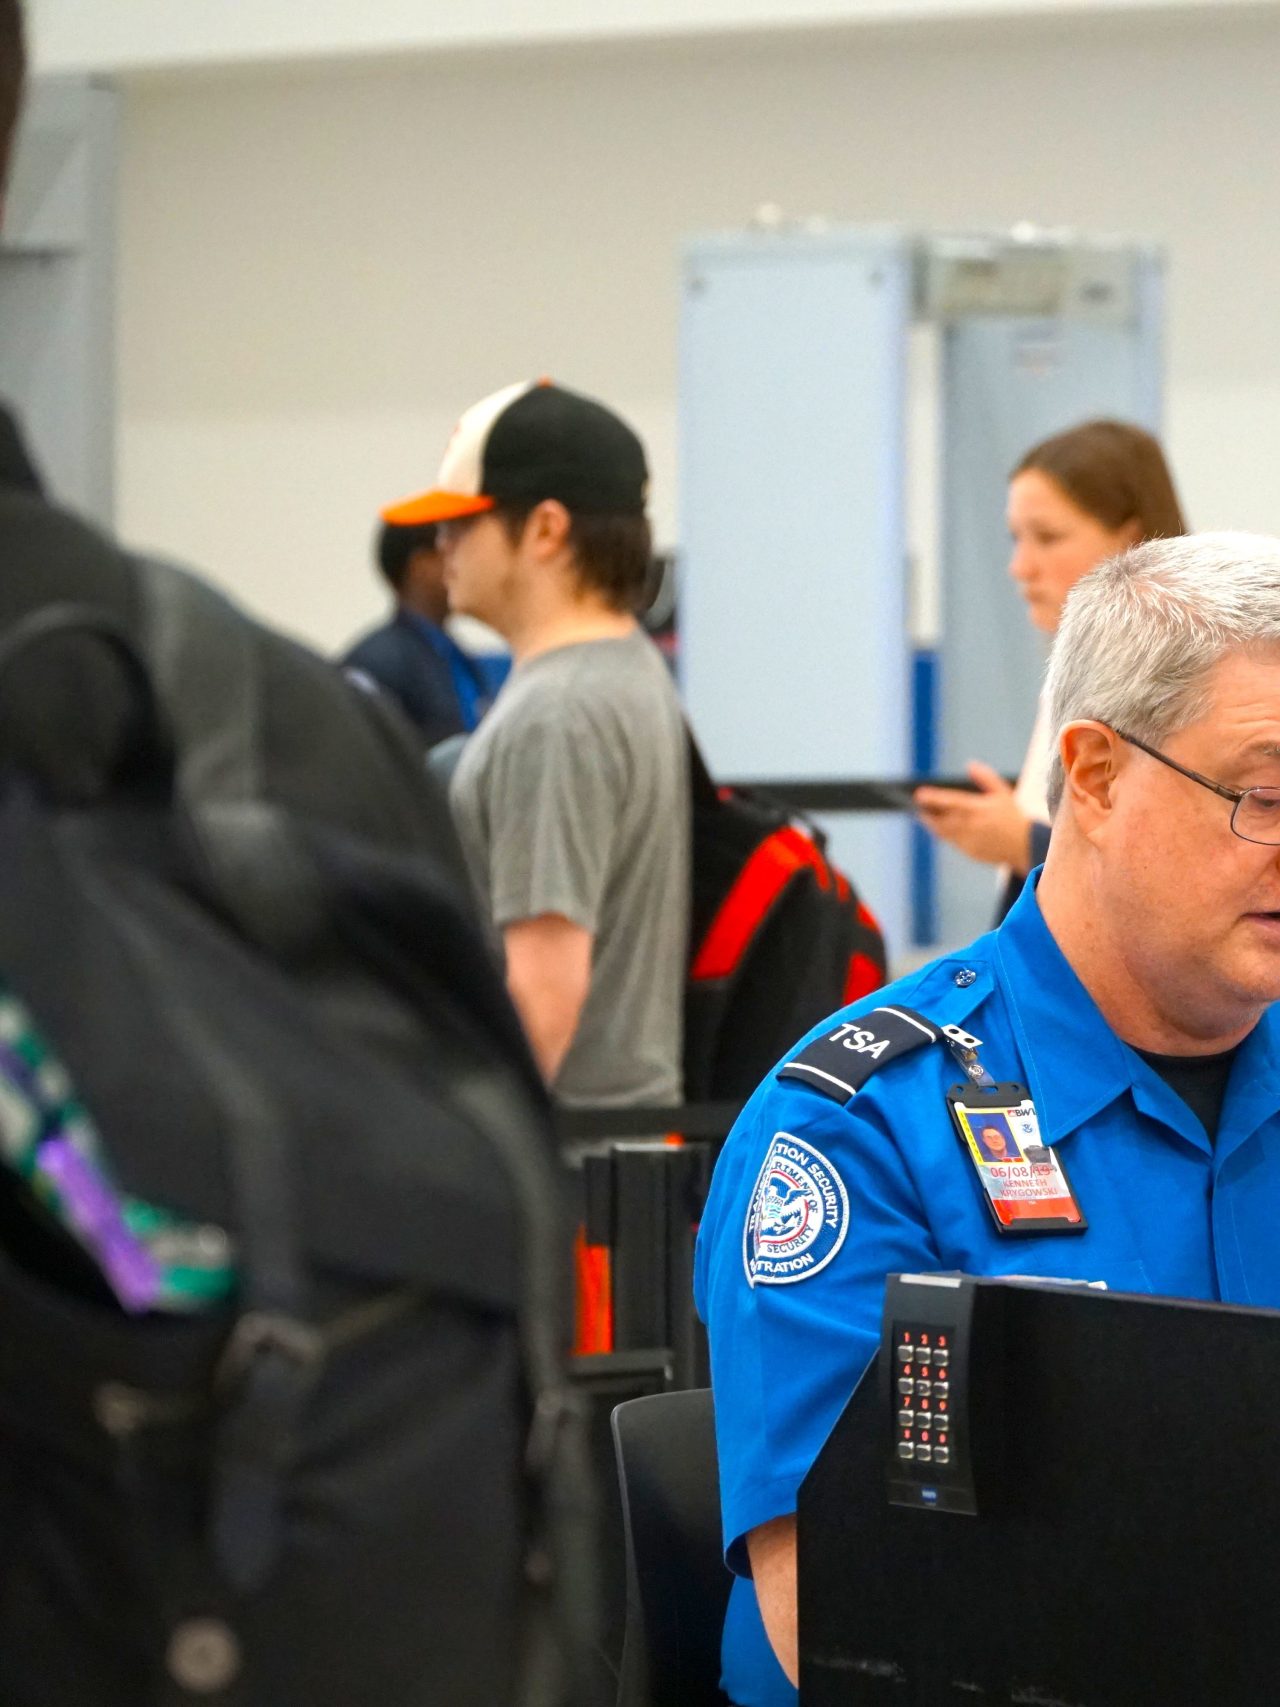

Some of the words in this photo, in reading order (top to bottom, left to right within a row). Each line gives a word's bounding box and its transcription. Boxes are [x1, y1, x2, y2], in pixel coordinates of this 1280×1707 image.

[829, 1023, 891, 1059] TSA
[774, 1161, 815, 1198] RTMENT
[808, 1199, 818, 1213] OF
[775, 1143, 809, 1167] TION
[807, 1163, 839, 1229] SECURITY
[1002, 1179, 1048, 1188] KENNETH
[766, 1223, 814, 1254] SECURITY
[904, 1331, 911, 1343] 1
[921, 1333, 929, 1345] 2
[938, 1335, 946, 1347] 3
[903, 1364, 912, 1375] 4
[904, 1395, 911, 1408] 7
